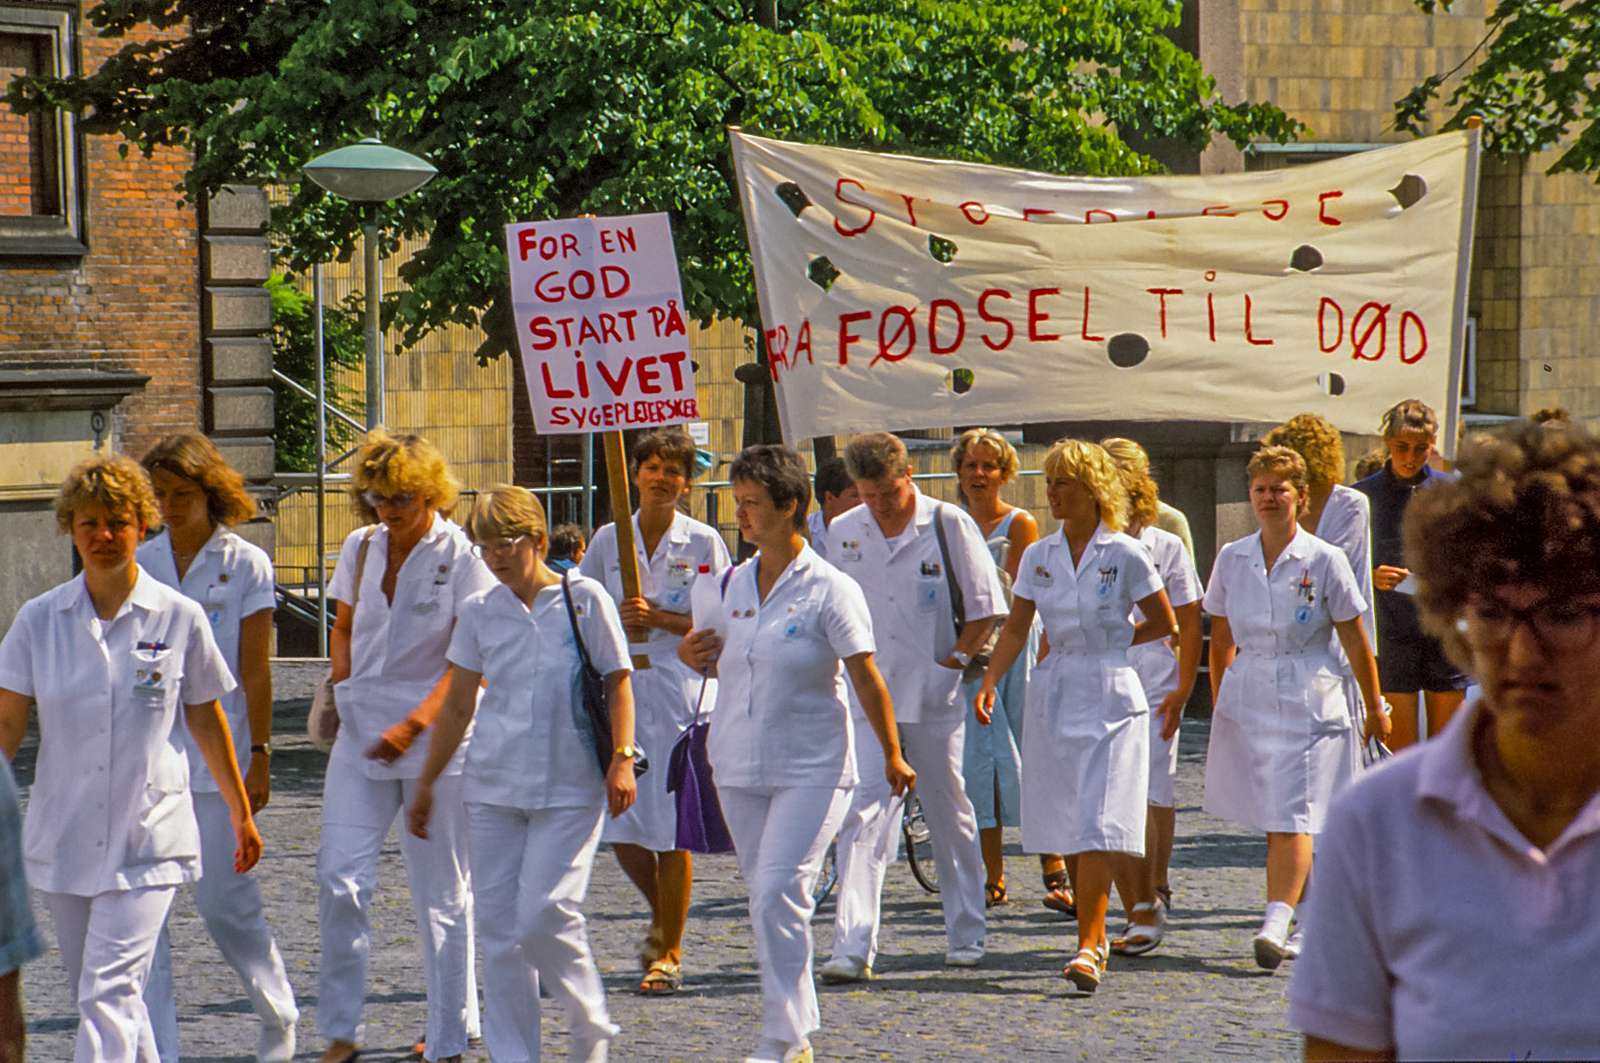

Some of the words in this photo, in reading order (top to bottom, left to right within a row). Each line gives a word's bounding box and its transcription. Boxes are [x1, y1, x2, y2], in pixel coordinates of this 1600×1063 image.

[517, 227, 581, 262] FOR
[599, 226, 638, 255] EN
[534, 264, 632, 304] GOD
[528, 309, 638, 351] START
[648, 298, 687, 338] PÅ
[764, 319, 814, 382] FRA
[838, 286, 1105, 369] FØDSEL
[1316, 295, 1429, 365] DØD
